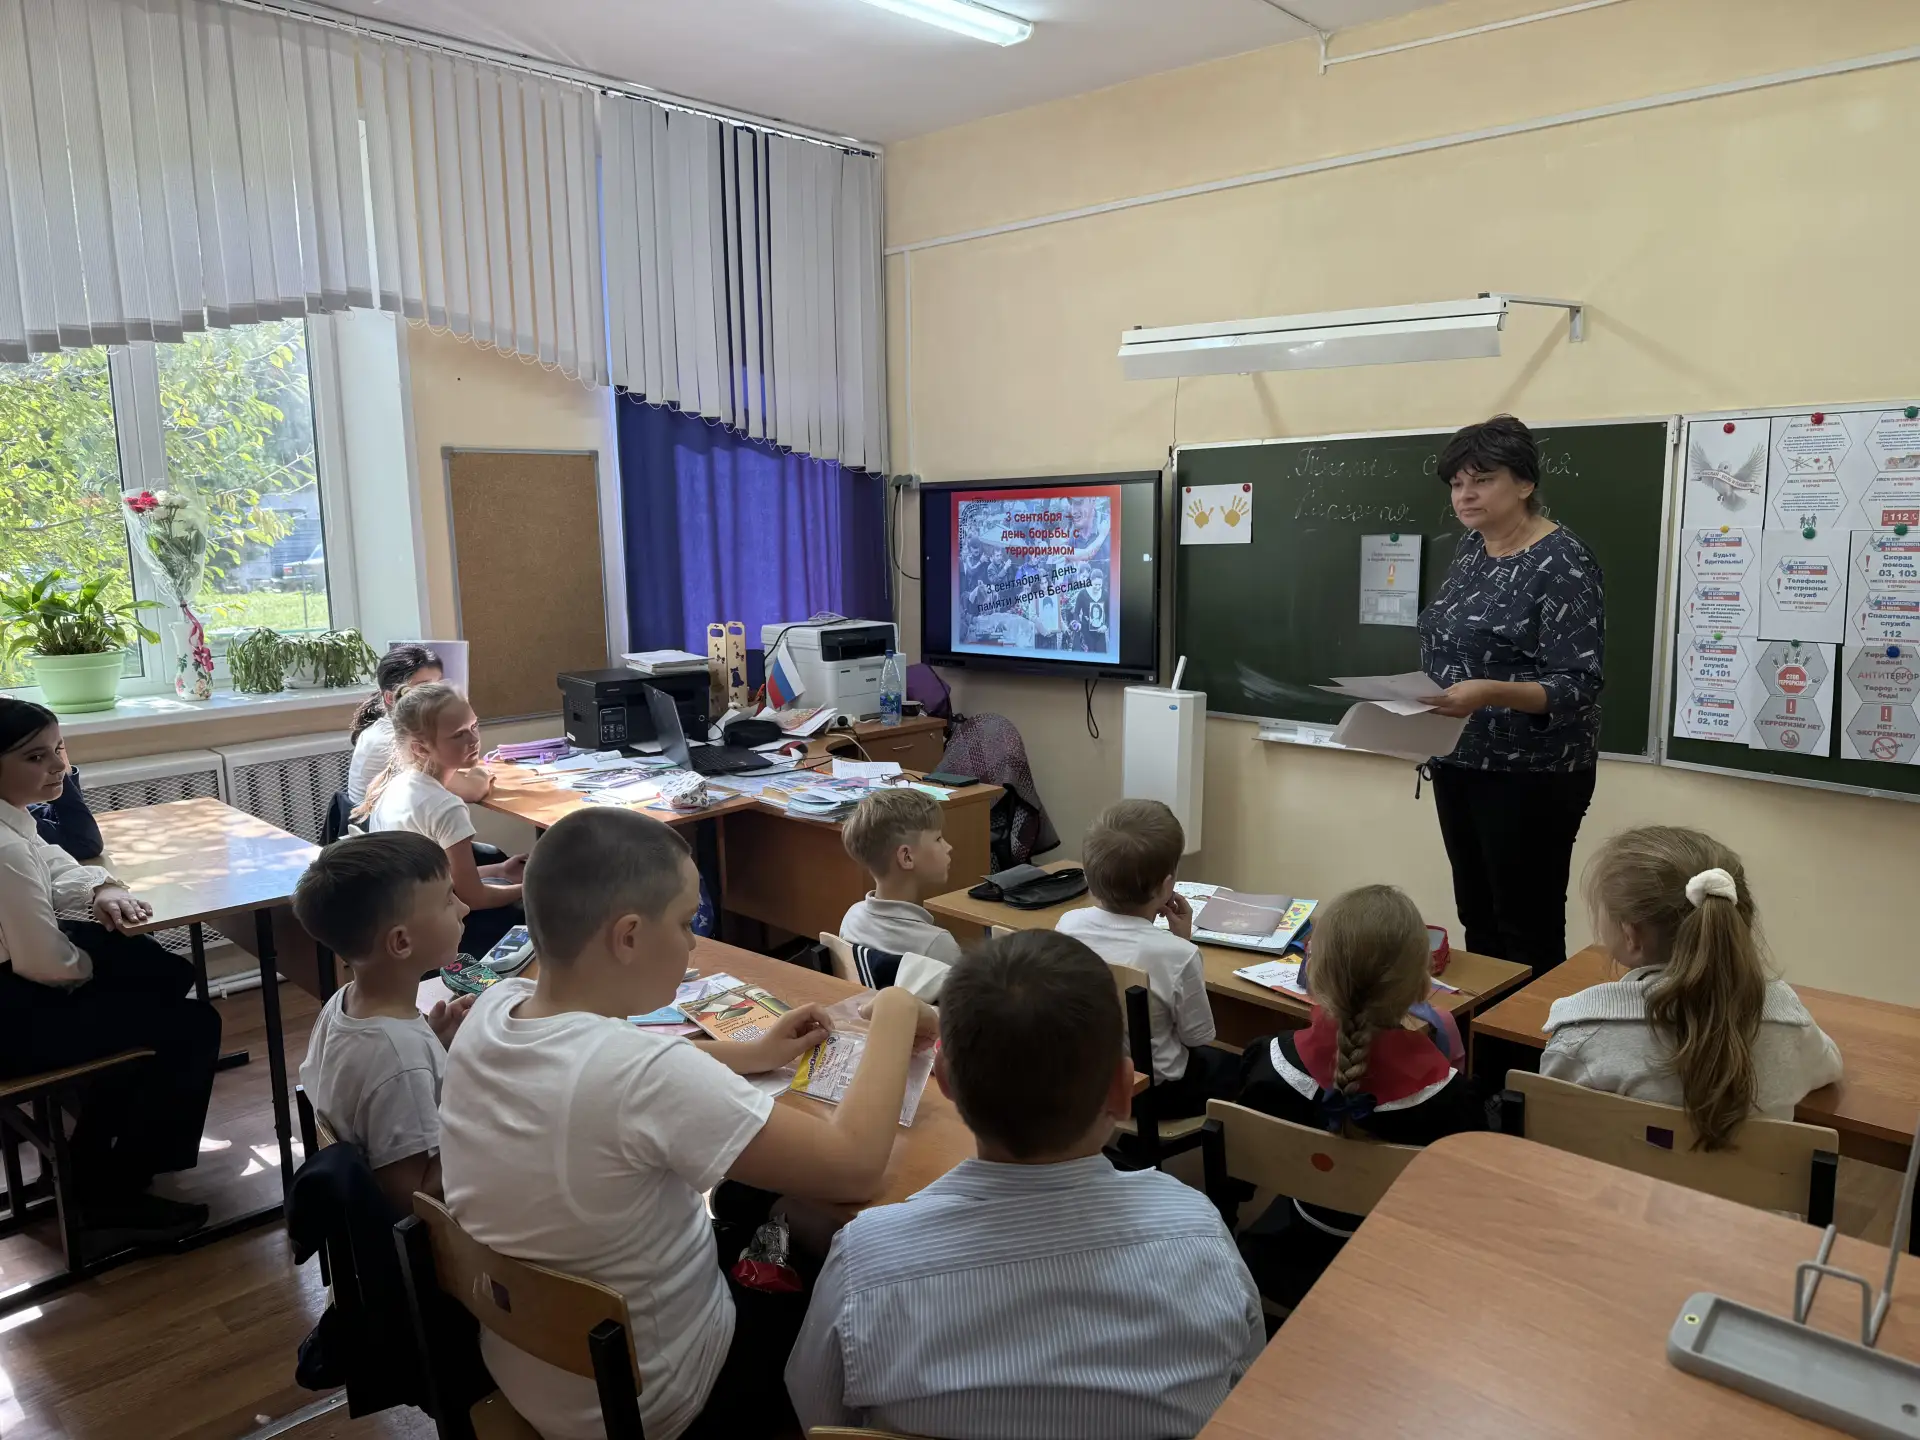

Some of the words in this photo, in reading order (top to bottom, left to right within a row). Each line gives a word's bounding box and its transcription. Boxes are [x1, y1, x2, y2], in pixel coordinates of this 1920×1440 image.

[1006, 511, 1012, 521] 3
[1014, 510, 1062, 524] сентября
[1890, 513, 1910, 521] 112
[1001, 529, 1026, 541] день
[1028, 527, 1070, 541] борьбы
[1073, 529, 1080, 539] с
[1005, 546, 1075, 558] терроризмом
[1879, 569, 1895, 578] 03,
[1898, 569, 1917, 577] 103
[986, 583, 992, 594] 3
[994, 573, 1041, 593] сентября
[1051, 565, 1077, 580] день
[977, 597, 1012, 613] памяти
[1014, 590, 1045, 605] жертв
[1047, 577, 1093, 596] Беслана
[1868, 612, 1920, 620] Спасательна
[1700, 669, 1713, 677] 01,
[1857, 671, 1920, 681] АНТИТЕРРОР
[1864, 684, 1892, 692] Террор
[1698, 710, 1729, 718] Полиция
[1697, 717, 1710, 725] 02,
[1760, 720, 1806, 729] ТЕРРОРИЗМУ
